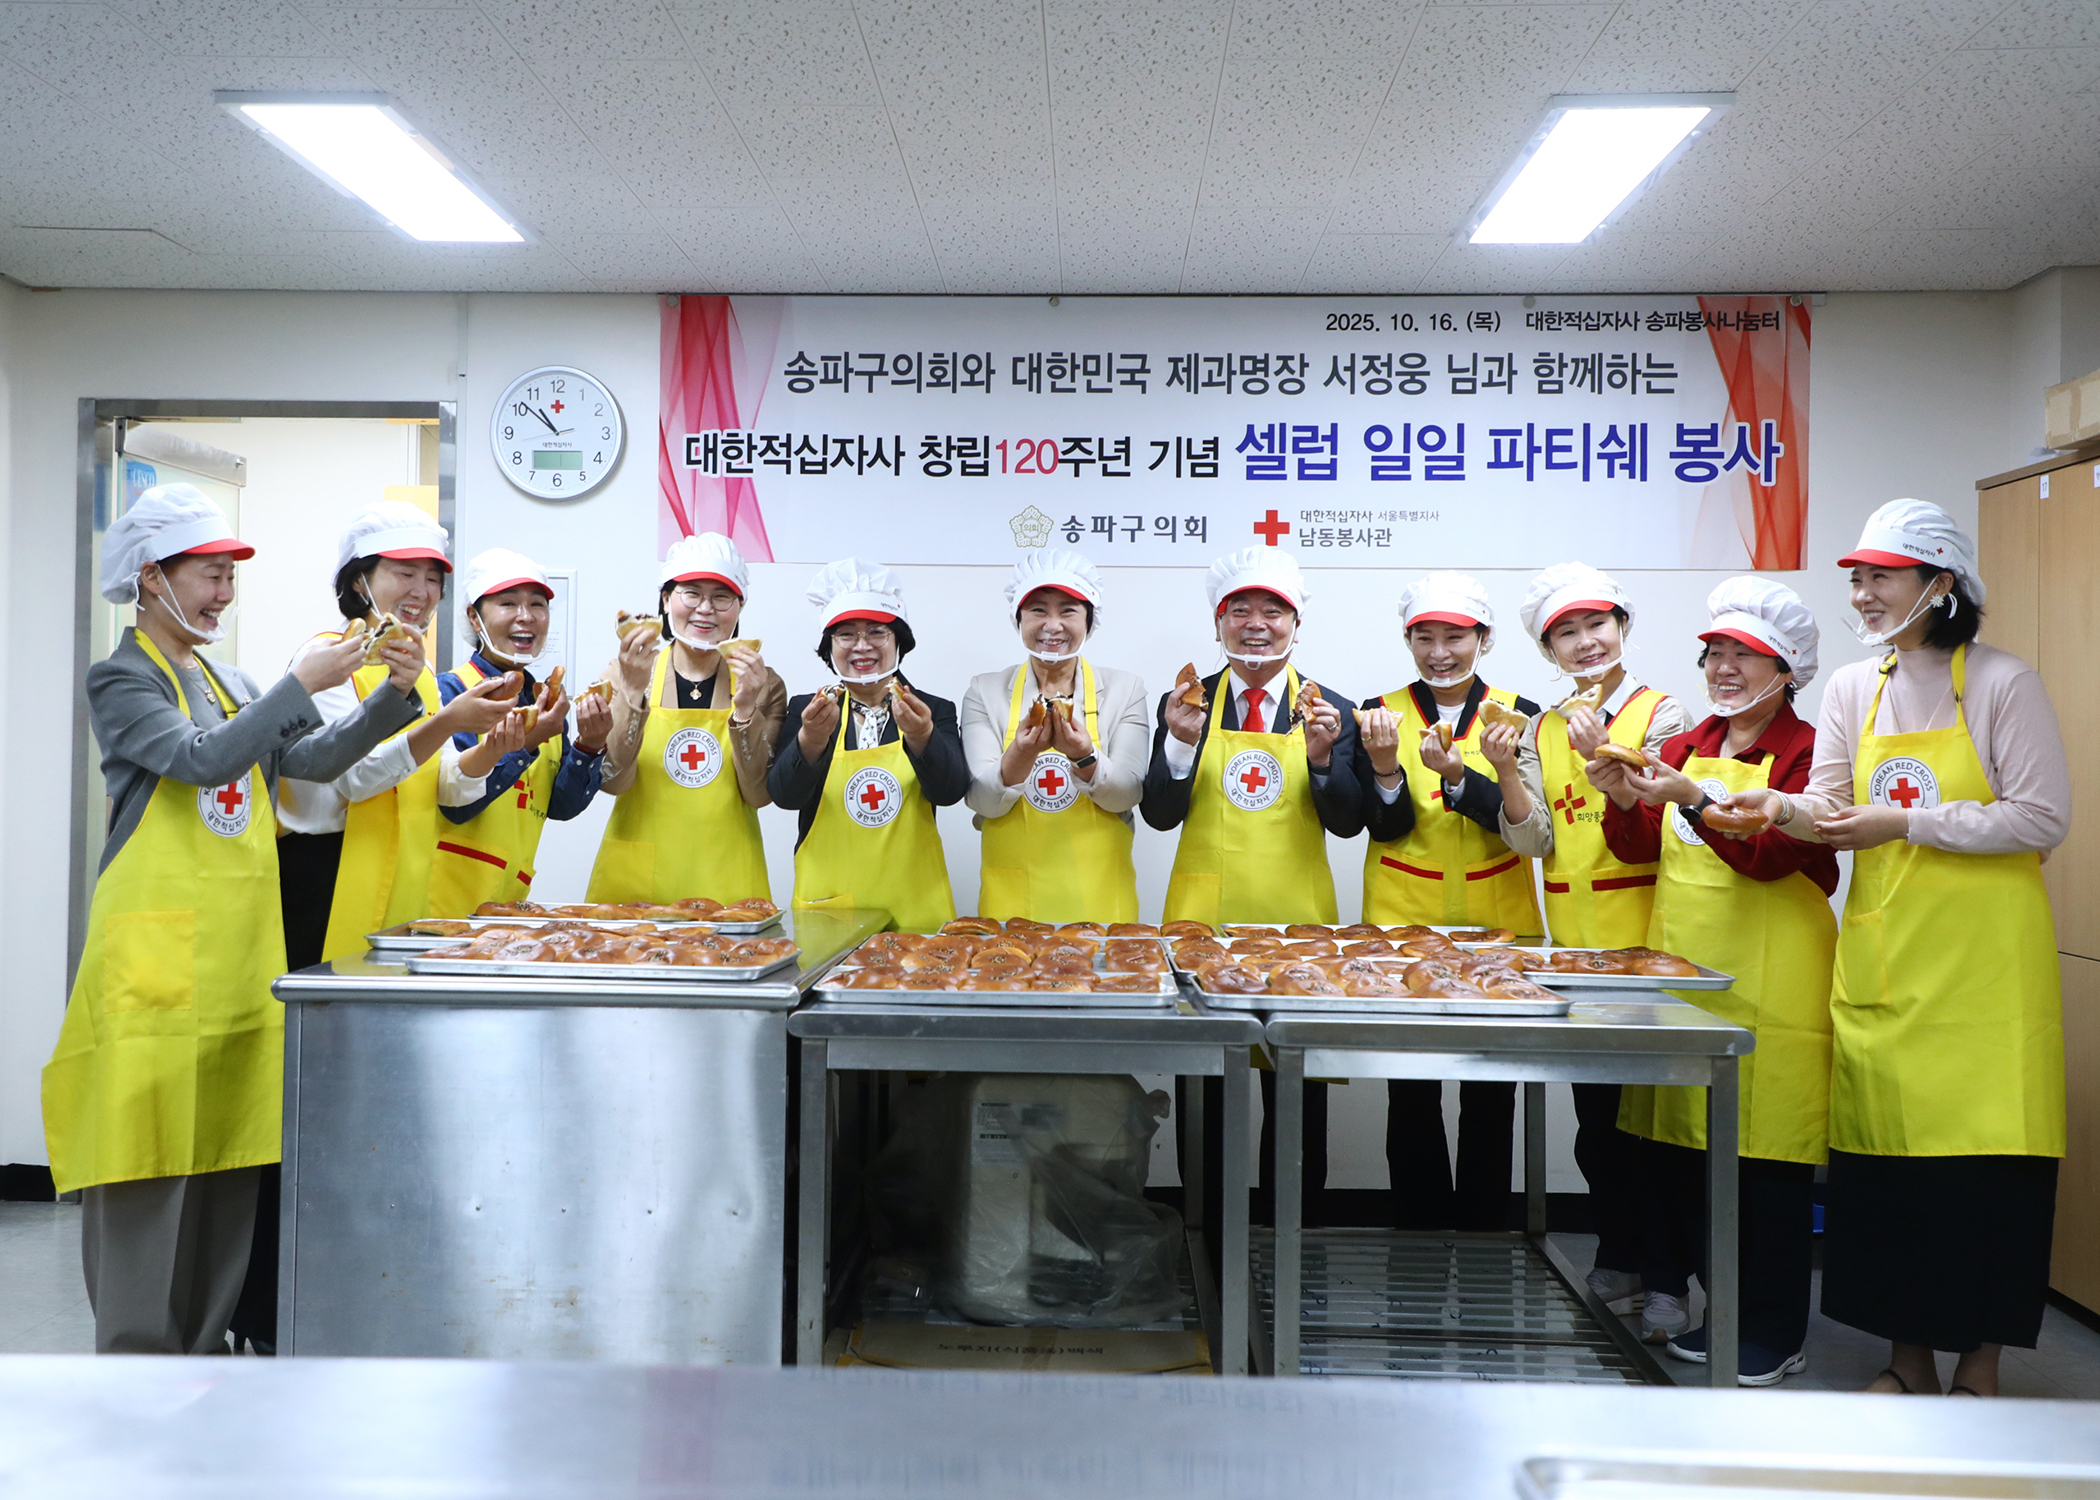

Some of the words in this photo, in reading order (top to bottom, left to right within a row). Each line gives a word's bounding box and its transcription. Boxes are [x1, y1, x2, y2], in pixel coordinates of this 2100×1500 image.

[1325, 312, 1381, 333] 2025.
[1390, 312, 1419, 333] 10.
[1429, 312, 1458, 333] 16.
[1466, 310, 1501, 333] (목)
[1526, 310, 1640, 332] 대한적십자사
[1644, 310, 1780, 332] 송파봉사나눔터
[783, 350, 995, 394] 송파구의회와
[1012, 350, 1151, 395] 대한민국
[1165, 351, 1310, 396] 제과명장
[1322, 352, 1431, 396] 서정웅
[1446, 352, 1518, 396] 님과
[1532, 352, 1678, 396] 함께하는
[526, 387, 540, 401] 11
[550, 379, 566, 394] 12
[579, 388, 585, 401] 1
[512, 403, 528, 417] 10
[594, 403, 604, 417] 2
[504, 426, 514, 440] 9
[601, 426, 611, 441] 3
[512, 451, 523, 465] 8
[593, 451, 603, 465] 4
[685, 432, 906, 476] 대한적십자사
[918, 434, 1133, 478] 창립120주년
[1148, 435, 1221, 478] 기념
[1235, 421, 1338, 482] 셀럽
[1363, 422, 1467, 482] 일일
[1486, 422, 1648, 483] 파티쉐
[1668, 421, 1783, 485] 봉사
[528, 470, 536, 482] 7
[552, 473, 563, 487] 6
[579, 470, 587, 482] 5
[1300, 509, 1373, 523] 대한적십자사
[1377, 510, 1440, 522] 서울특별지사
[1060, 515, 1209, 544] 송파구의회
[1299, 527, 1392, 548] 남동봉사관
[668, 732, 688, 759] KOREAN
[687, 731, 701, 739] RED
[702, 735, 718, 756] CROSS
[1045, 756, 1060, 764] RED
[674, 768, 714, 784] 대한적십자사
[1229, 754, 1252, 777] KOREAN
[1253, 754, 1268, 763] RED
[1267, 761, 1279, 785] CROSS
[848, 773, 865, 801] KOREAN
[864, 771, 879, 779] RED
[879, 773, 897, 794] CROSS
[1874, 764, 1894, 797] KOREAN
[1895, 762, 1913, 771] RED
[1914, 765, 1934, 792] CROSS
[1032, 793, 1073, 809] 대한적십자사
[1231, 788, 1270, 807] 대한적십자사
[207, 810, 247, 832] 대한적십자사
[856, 806, 895, 823] 대한적십자사
